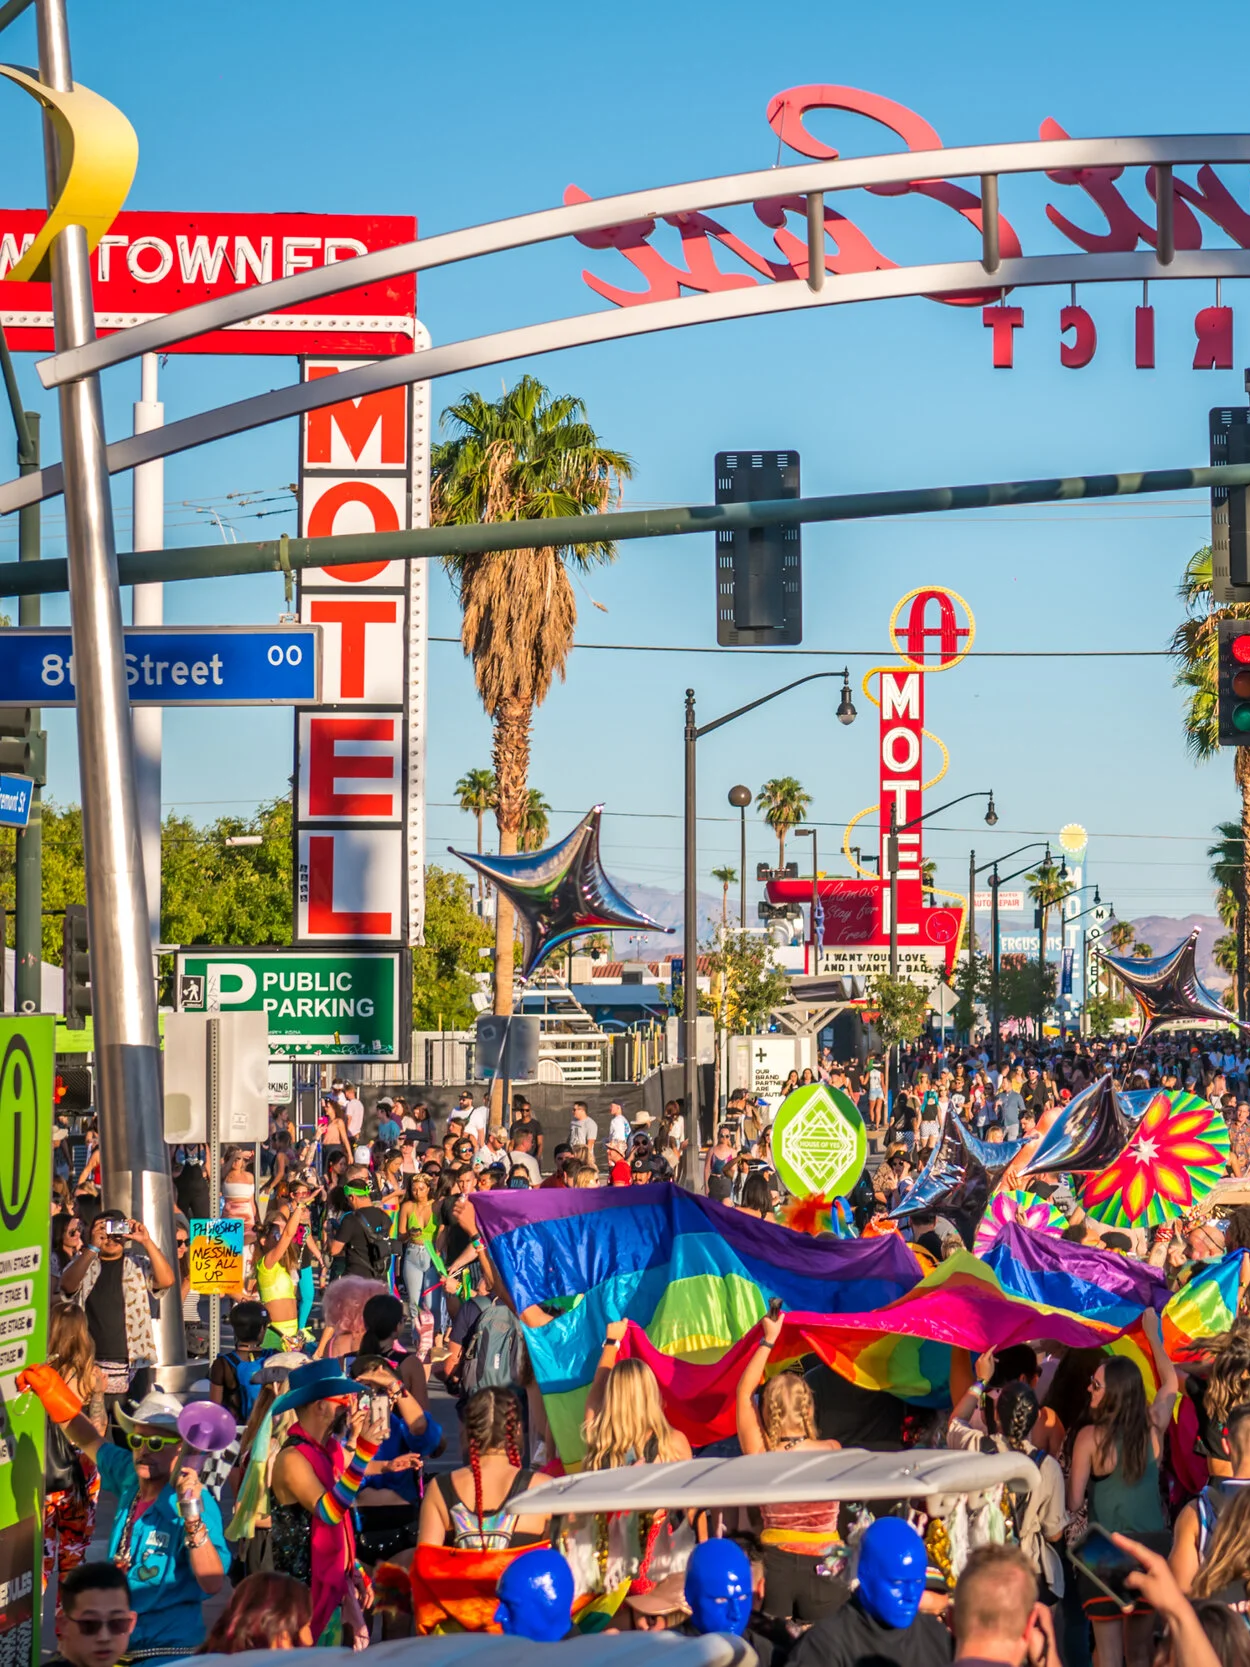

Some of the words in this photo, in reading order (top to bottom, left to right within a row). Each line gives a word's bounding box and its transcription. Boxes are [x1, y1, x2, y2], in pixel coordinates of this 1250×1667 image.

[307, 367, 406, 935] MOTEL
[41, 653, 77, 686] 8t
[124, 653, 223, 686] Street
[267, 645, 302, 666] 00
[881, 673, 920, 936] MOTEL
[999, 899, 1019, 907] EPAIR
[1000, 936, 1062, 951] ERGUSNS
[824, 964, 845, 972] AND
[857, 964, 886, 972] WANT
[906, 964, 927, 972] BAD
[207, 963, 257, 1012] P
[263, 972, 352, 992] PUBLIC
[263, 998, 374, 1018] PARKING
[208, 1234, 223, 1245] IS
[192, 1245, 241, 1261] MESSING
[14, 1255, 31, 1271] STAGE
[195, 1260, 210, 1271] US
[215, 1259, 238, 1269] ALL
[205, 1271, 223, 1281] UP
[5, 1287, 22, 1304] STAGE
[8, 1317, 25, 1334] STAGE
